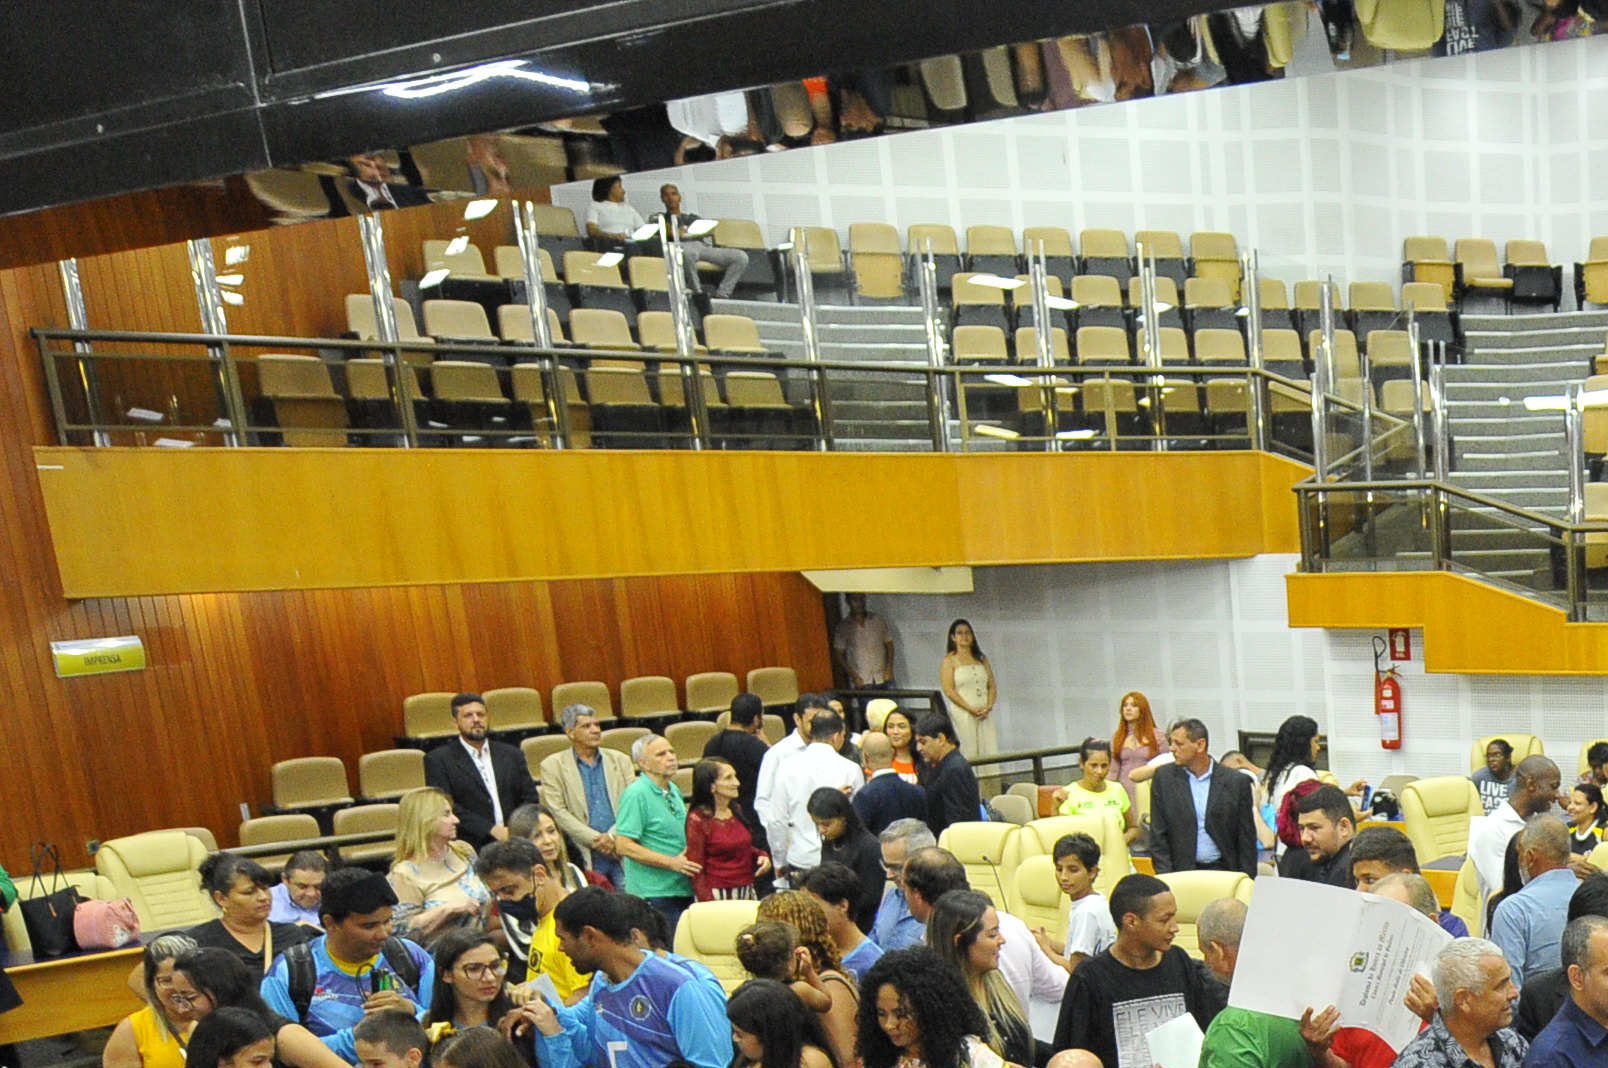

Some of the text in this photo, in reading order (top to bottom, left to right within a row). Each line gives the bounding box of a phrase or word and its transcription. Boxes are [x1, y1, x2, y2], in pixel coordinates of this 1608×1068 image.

[83, 653, 122, 666] IMPRENSA
[1480, 780, 1508, 797] LIVE
[1480, 795, 1509, 810] FAS
